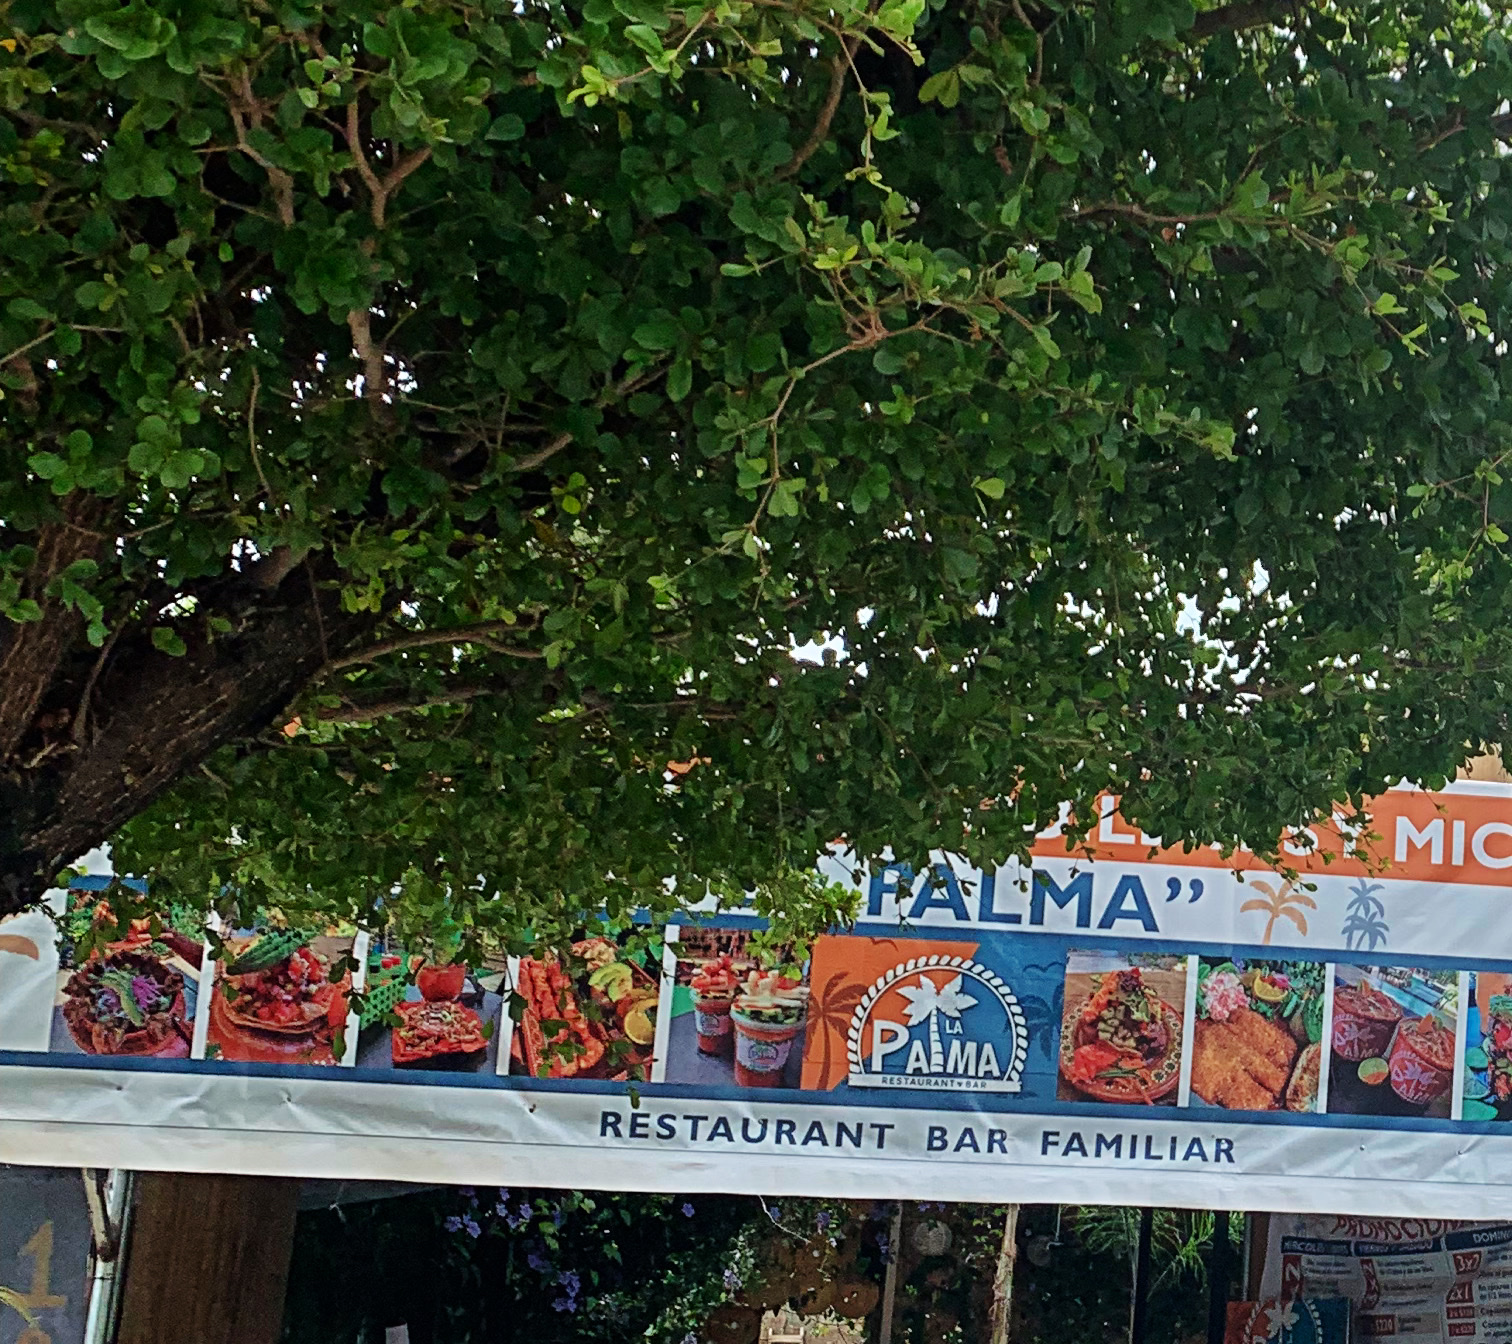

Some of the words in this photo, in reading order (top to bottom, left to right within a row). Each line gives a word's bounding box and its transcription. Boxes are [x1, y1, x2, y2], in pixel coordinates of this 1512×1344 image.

[945, 1019, 964, 1035] LA
[871, 1019, 1001, 1078] PALMA
[881, 1075, 956, 1088] RESTAURANT
[965, 1080, 987, 1089] BAR
[600, 1110, 894, 1151] RESTAURANT
[926, 1125, 1010, 1155] BAR
[1040, 1130, 1237, 1164] FAMILIAR
